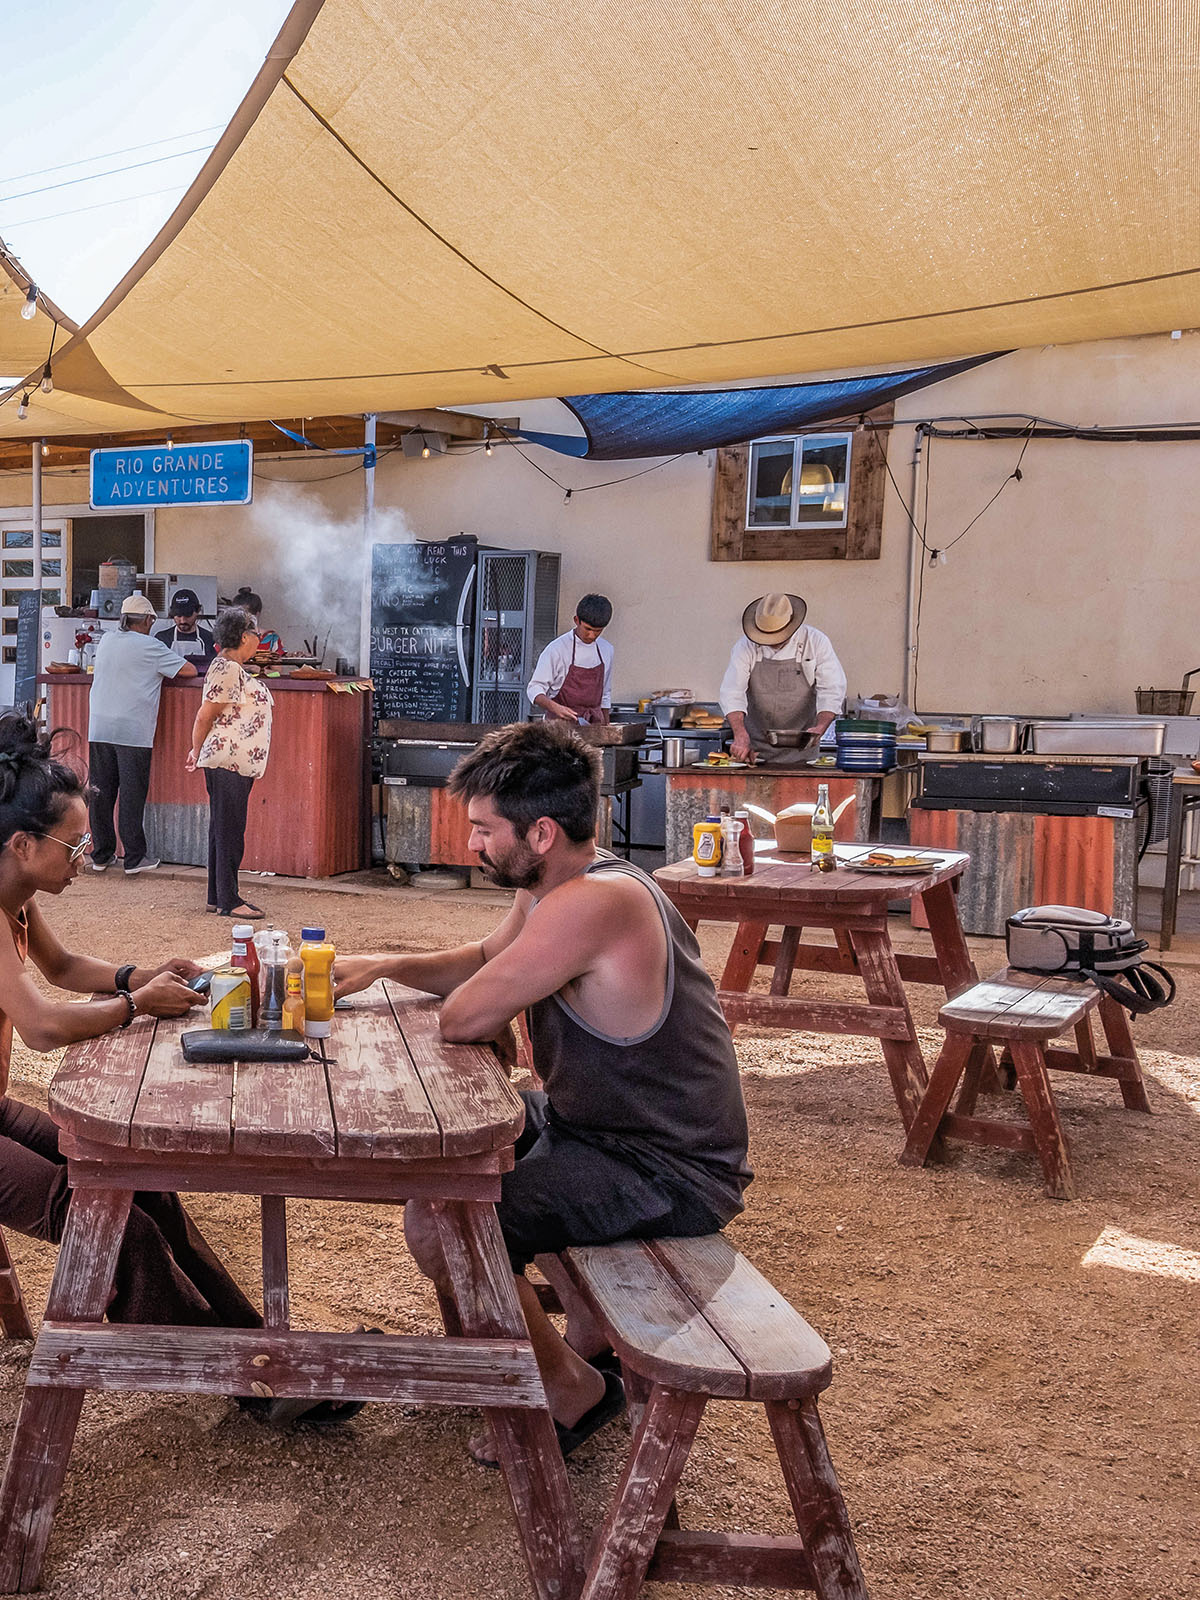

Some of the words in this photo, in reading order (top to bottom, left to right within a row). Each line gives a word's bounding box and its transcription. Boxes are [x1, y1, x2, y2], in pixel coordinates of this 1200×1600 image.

[115, 457, 143, 475] RIO
[152, 453, 224, 472] GRANDE
[110, 476, 229, 498] ADVENTURES
[427, 546, 446, 556] READ
[450, 546, 467, 556] THIS
[400, 627, 409, 635] TX
[371, 636, 418, 654] BURGER
[424, 637, 457, 654] NITE
[386, 711, 401, 719] SAM
